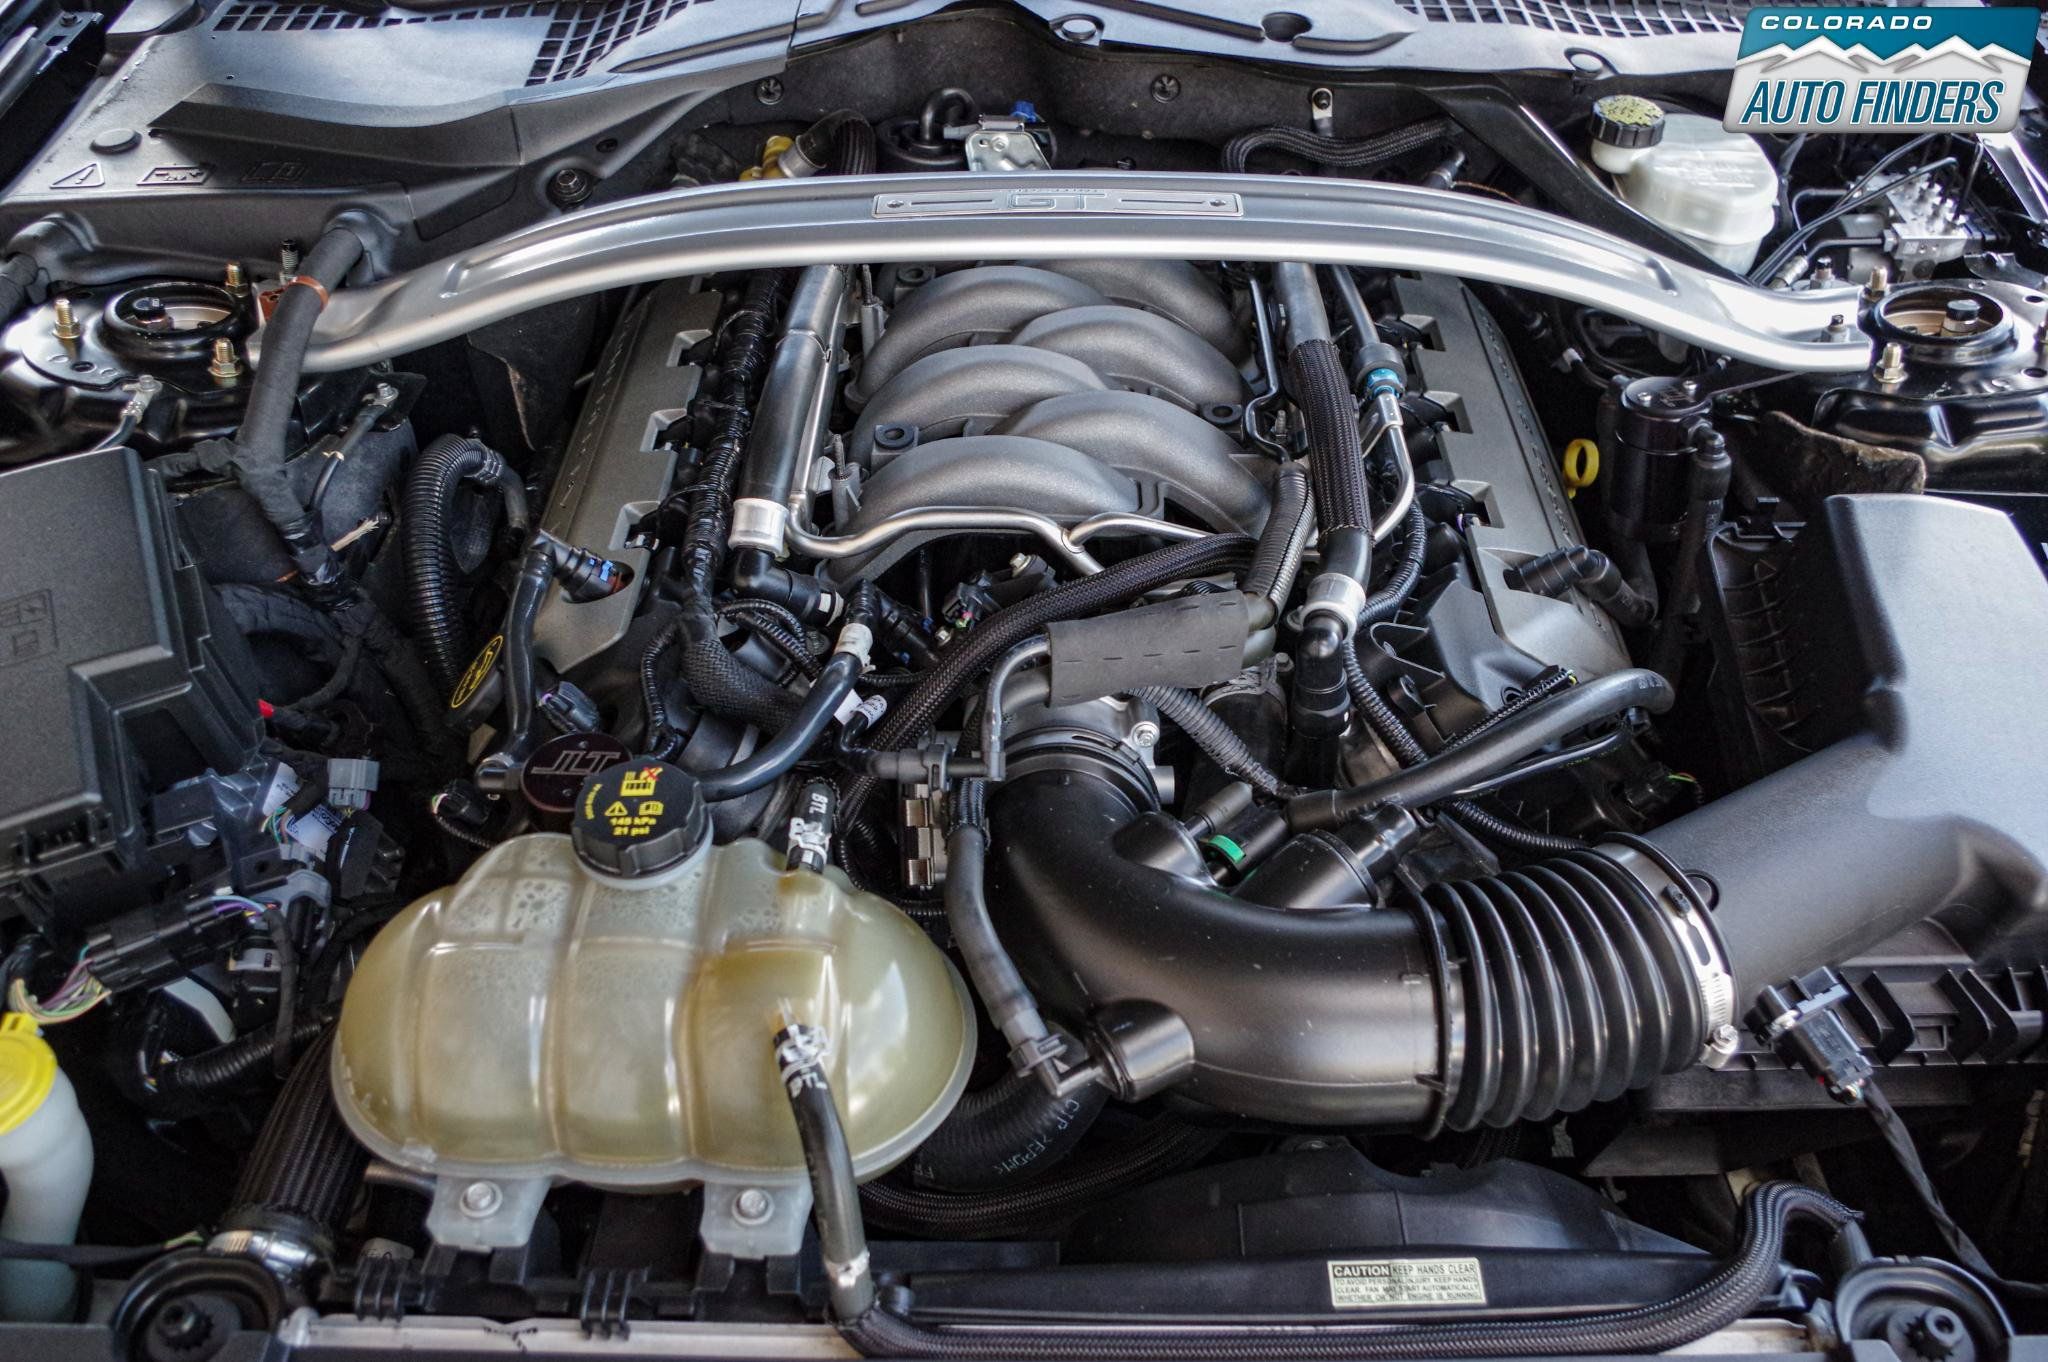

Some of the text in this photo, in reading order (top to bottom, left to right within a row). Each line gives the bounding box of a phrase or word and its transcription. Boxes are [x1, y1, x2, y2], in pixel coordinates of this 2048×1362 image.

[1007, 192, 1107, 210] GT
[531, 750, 621, 776] JLT
[613, 826, 650, 837] 21 psi
[1333, 1264, 1475, 1277] CAUTION KEEP HANDS CLEAR
